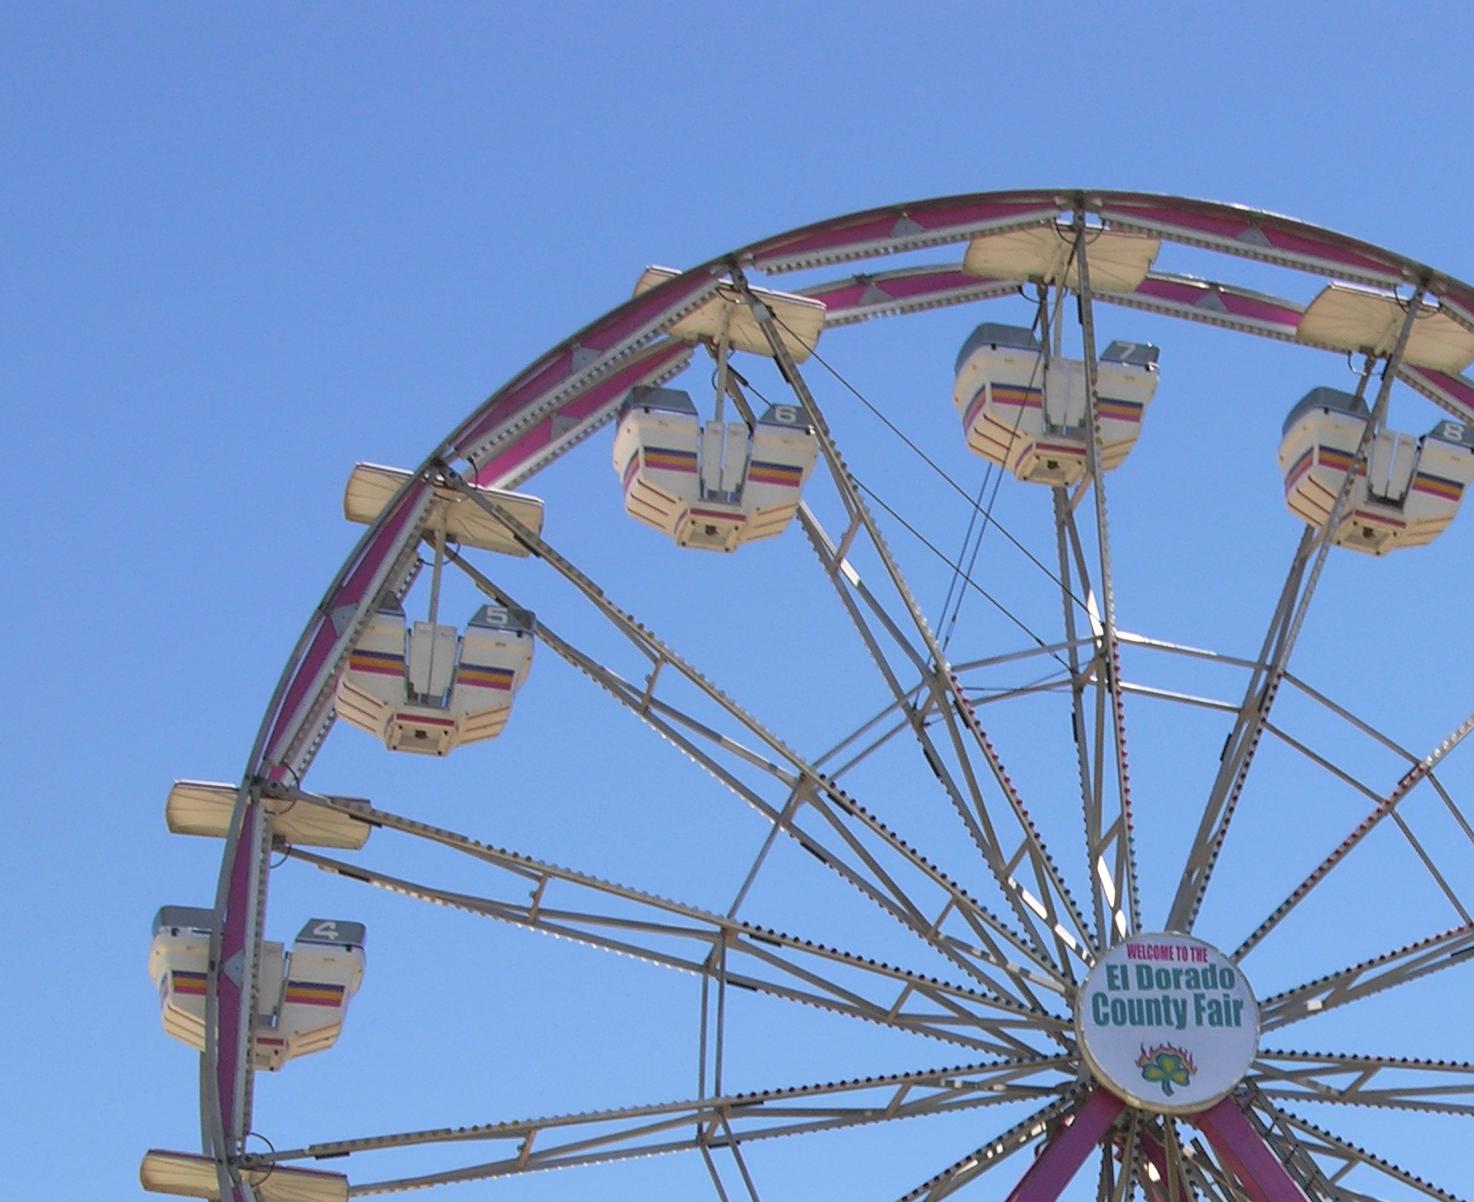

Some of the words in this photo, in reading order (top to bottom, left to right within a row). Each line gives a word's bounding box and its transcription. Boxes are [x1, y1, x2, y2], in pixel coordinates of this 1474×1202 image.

[1116, 342, 1136, 360] 7
[775, 406, 796, 422] 6
[1443, 422, 1464, 442] 8
[486, 606, 508, 625] 5
[313, 922, 339, 940] 4
[1127, 943, 1174, 961] WELCOME
[1175, 946, 1189, 962] TO
[1191, 947, 1208, 963] THE
[1106, 964, 1130, 991] El
[1135, 964, 1236, 991] Dorado
[1092, 992, 1187, 1030] County
[1194, 993, 1244, 1028] Fair
